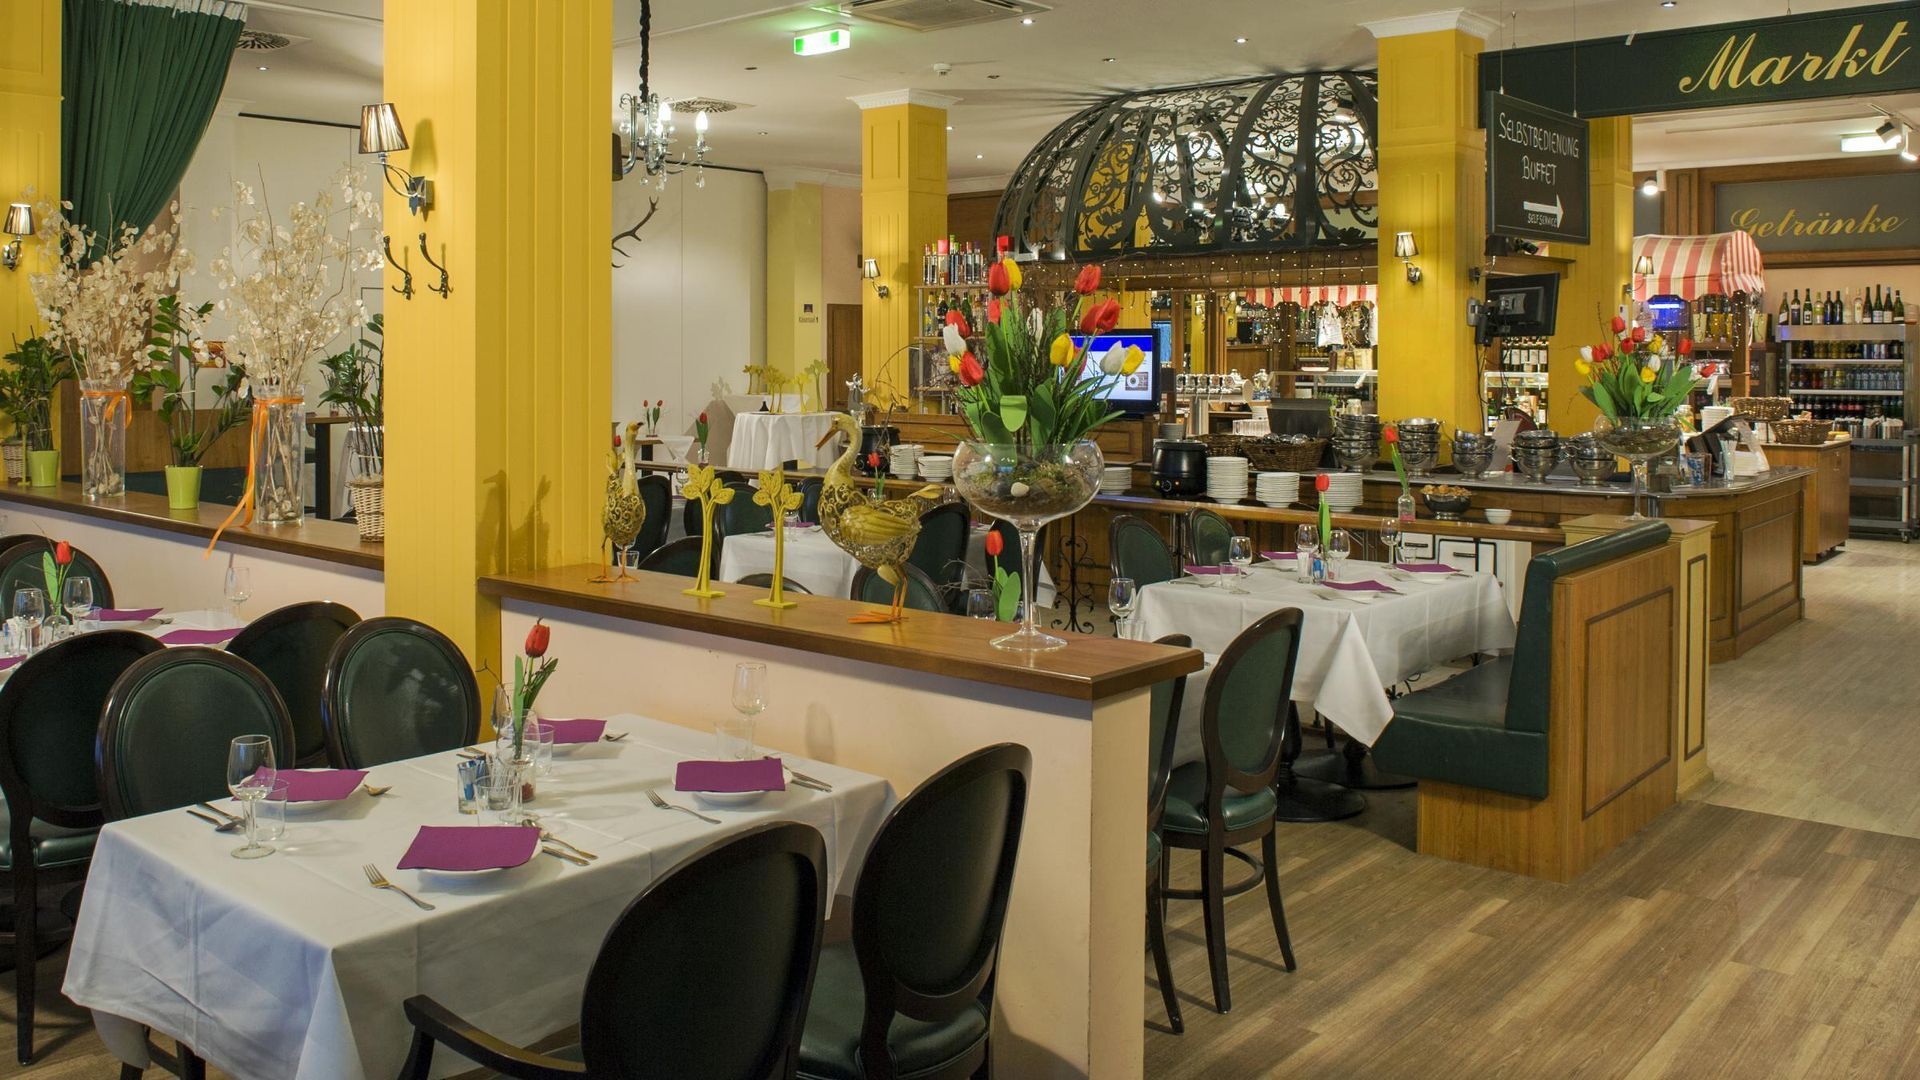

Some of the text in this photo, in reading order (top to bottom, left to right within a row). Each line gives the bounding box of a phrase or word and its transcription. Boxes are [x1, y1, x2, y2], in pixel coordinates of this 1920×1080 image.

[1679, 21, 1911, 93] Markt
[1499, 111, 1580, 158] SELBSTBEDIENUNG
[1522, 155, 1557, 185] BUFFET
[1731, 204, 1908, 238] Getränke
